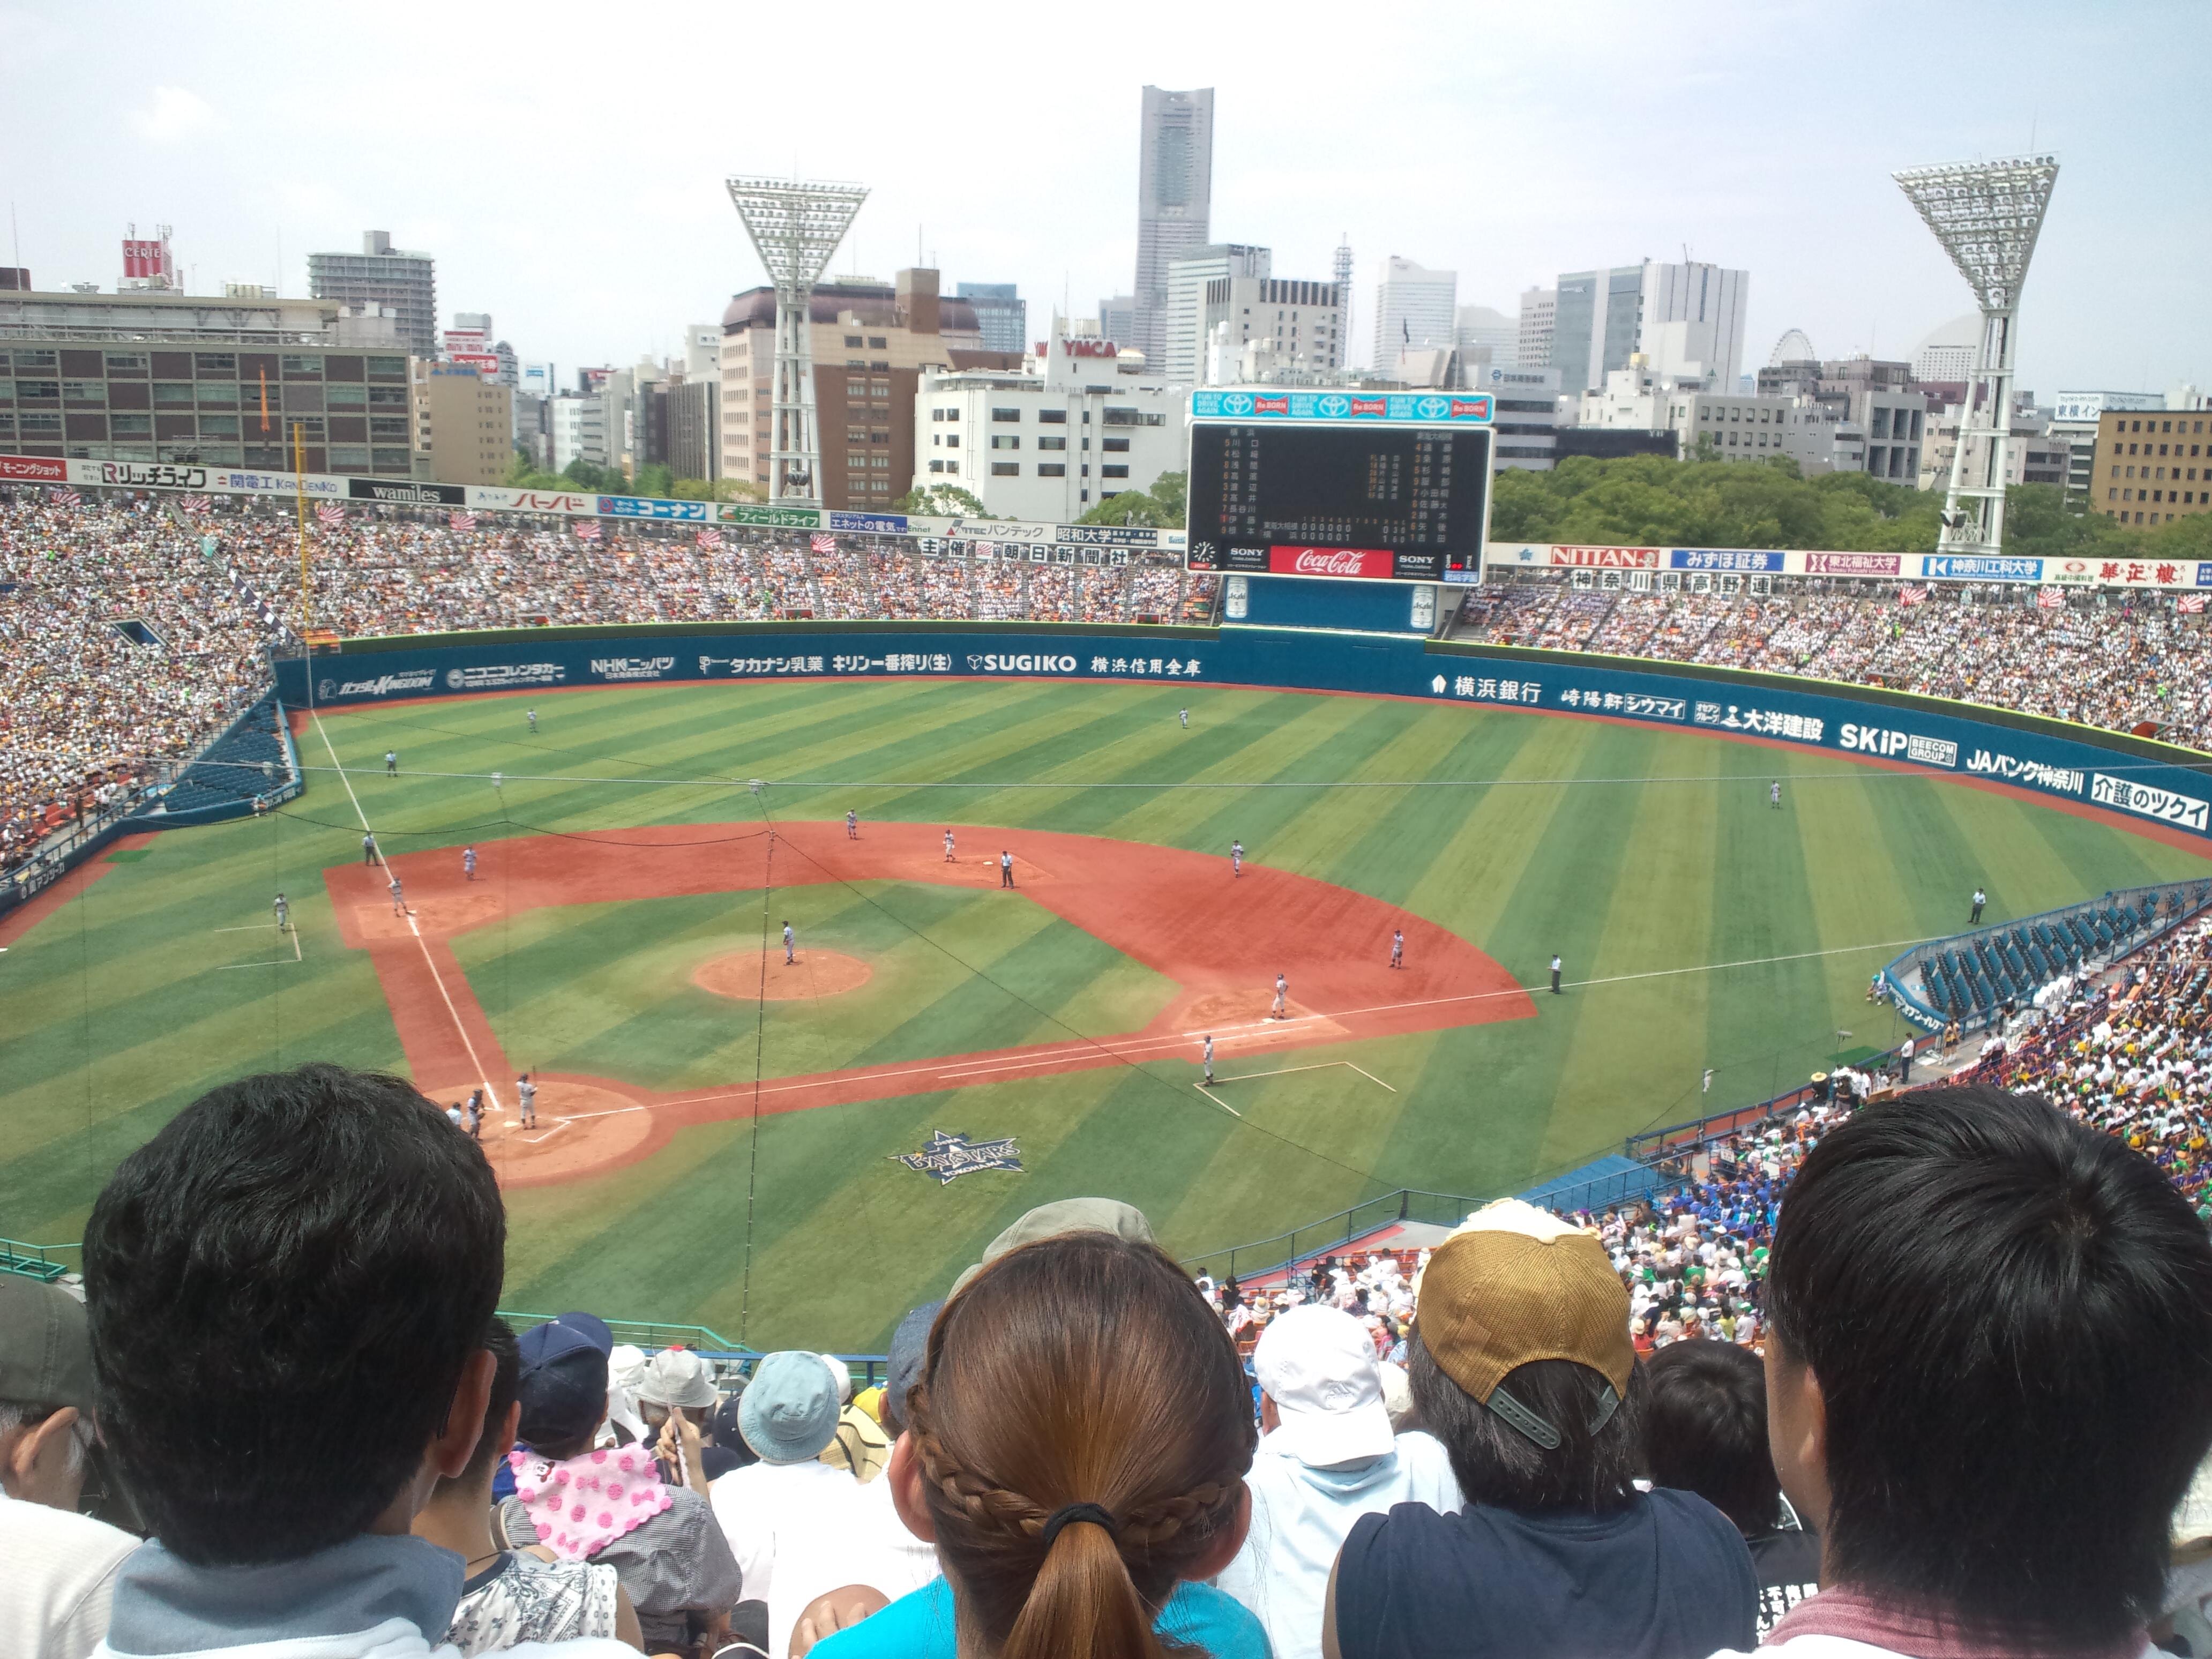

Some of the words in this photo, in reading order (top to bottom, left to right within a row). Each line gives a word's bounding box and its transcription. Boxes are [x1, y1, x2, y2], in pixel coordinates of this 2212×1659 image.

[1063, 339, 1117, 357] YMCA
[2058, 405, 2101, 417] 東横イン
[3, 462, 61, 476] モーニングショット
[119, 464, 206, 488] リッチライフ
[230, 474, 273, 489] 関電工
[372, 485, 441, 503] wamiles
[638, 501, 705, 518] コーナン
[739, 512, 819, 526] フィールドライフ
[1302, 522, 1306, 530] 0
[988, 524, 1043, 537] バンテック
[1057, 527, 1111, 542] 昭和大学
[1301, 532, 1306, 540] 0
[1310, 532, 1315, 540] 0
[1327, 533, 1332, 541] 0
[1296, 549, 1366, 574] Coca-Cola
[1399, 555, 1435, 563] SONY
[1552, 548, 1636, 566] NITTAN
[1686, 552, 1768, 570] みずほ証券
[1829, 556, 1897, 570] 東北福祉大学
[1952, 559, 2038, 574] 神奈川工科大学
[591, 657, 674, 673] NHKニッパツ
[730, 655, 823, 673] タカナシ乳業
[984, 654, 1077, 671] SUGIKO
[1090, 656, 1201, 677] 横浜信用金庫
[1454, 675, 1542, 703] 横浜銀行
[1561, 689, 1624, 711] 崎陽軒
[1626, 697, 1684, 718] シウマイ
[1743, 708, 1824, 742] 大洋建設
[1911, 747, 1946, 761] GROUP
[1912, 738, 1954, 755] BEECOM
[1967, 749, 2084, 795] JAバンク神奈川
[2095, 777, 2207, 826] 介護のツクイ
[933, 1138, 964, 1147] DeNA
[900, 1144, 1021, 1171] BAYSTARS
[941, 1160, 1006, 1177] YOKOHAMA
